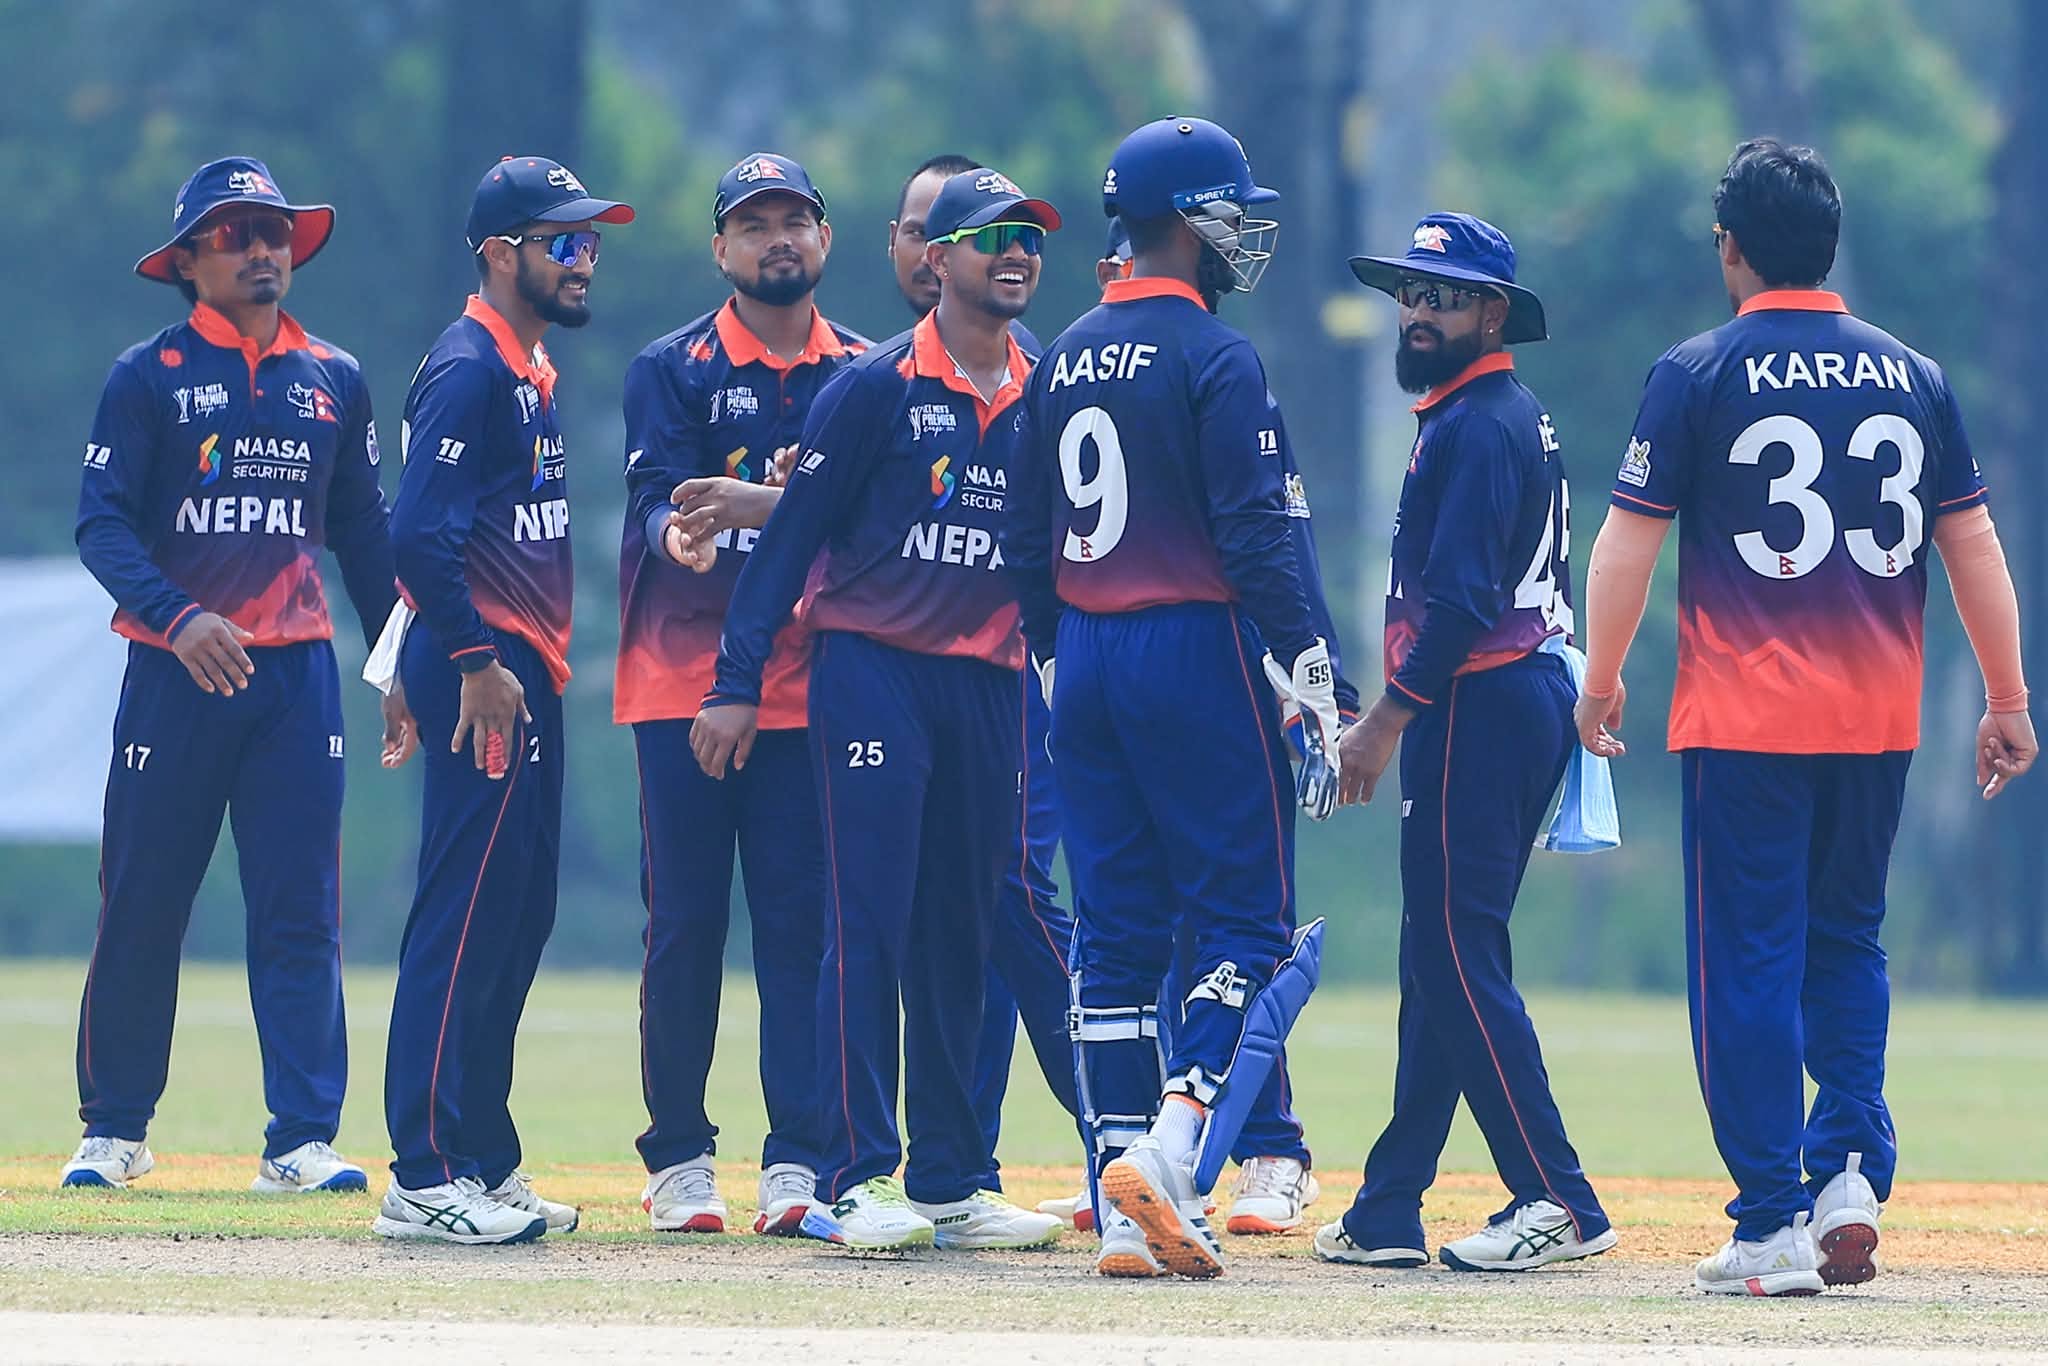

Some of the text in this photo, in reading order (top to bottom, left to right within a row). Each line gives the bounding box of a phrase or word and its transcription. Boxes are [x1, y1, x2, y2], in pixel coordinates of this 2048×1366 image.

[1194, 189, 1225, 202] SHREY
[1049, 342, 1158, 393] AASIF
[1745, 352, 1912, 394] KARAN
[922, 413, 957, 427] PREMIER
[233, 437, 312, 462] NAASA
[232, 464, 308, 483] SECURITIES
[1058, 405, 1130, 564] 9
[1728, 413, 1926, 580] 33
[175, 496, 307, 538] NEPAL
[1308, 663, 1330, 686] SS
[124, 742, 151, 771] 17
[847, 741, 885, 768] 25
[934, 1212, 970, 1225] LOTTO
